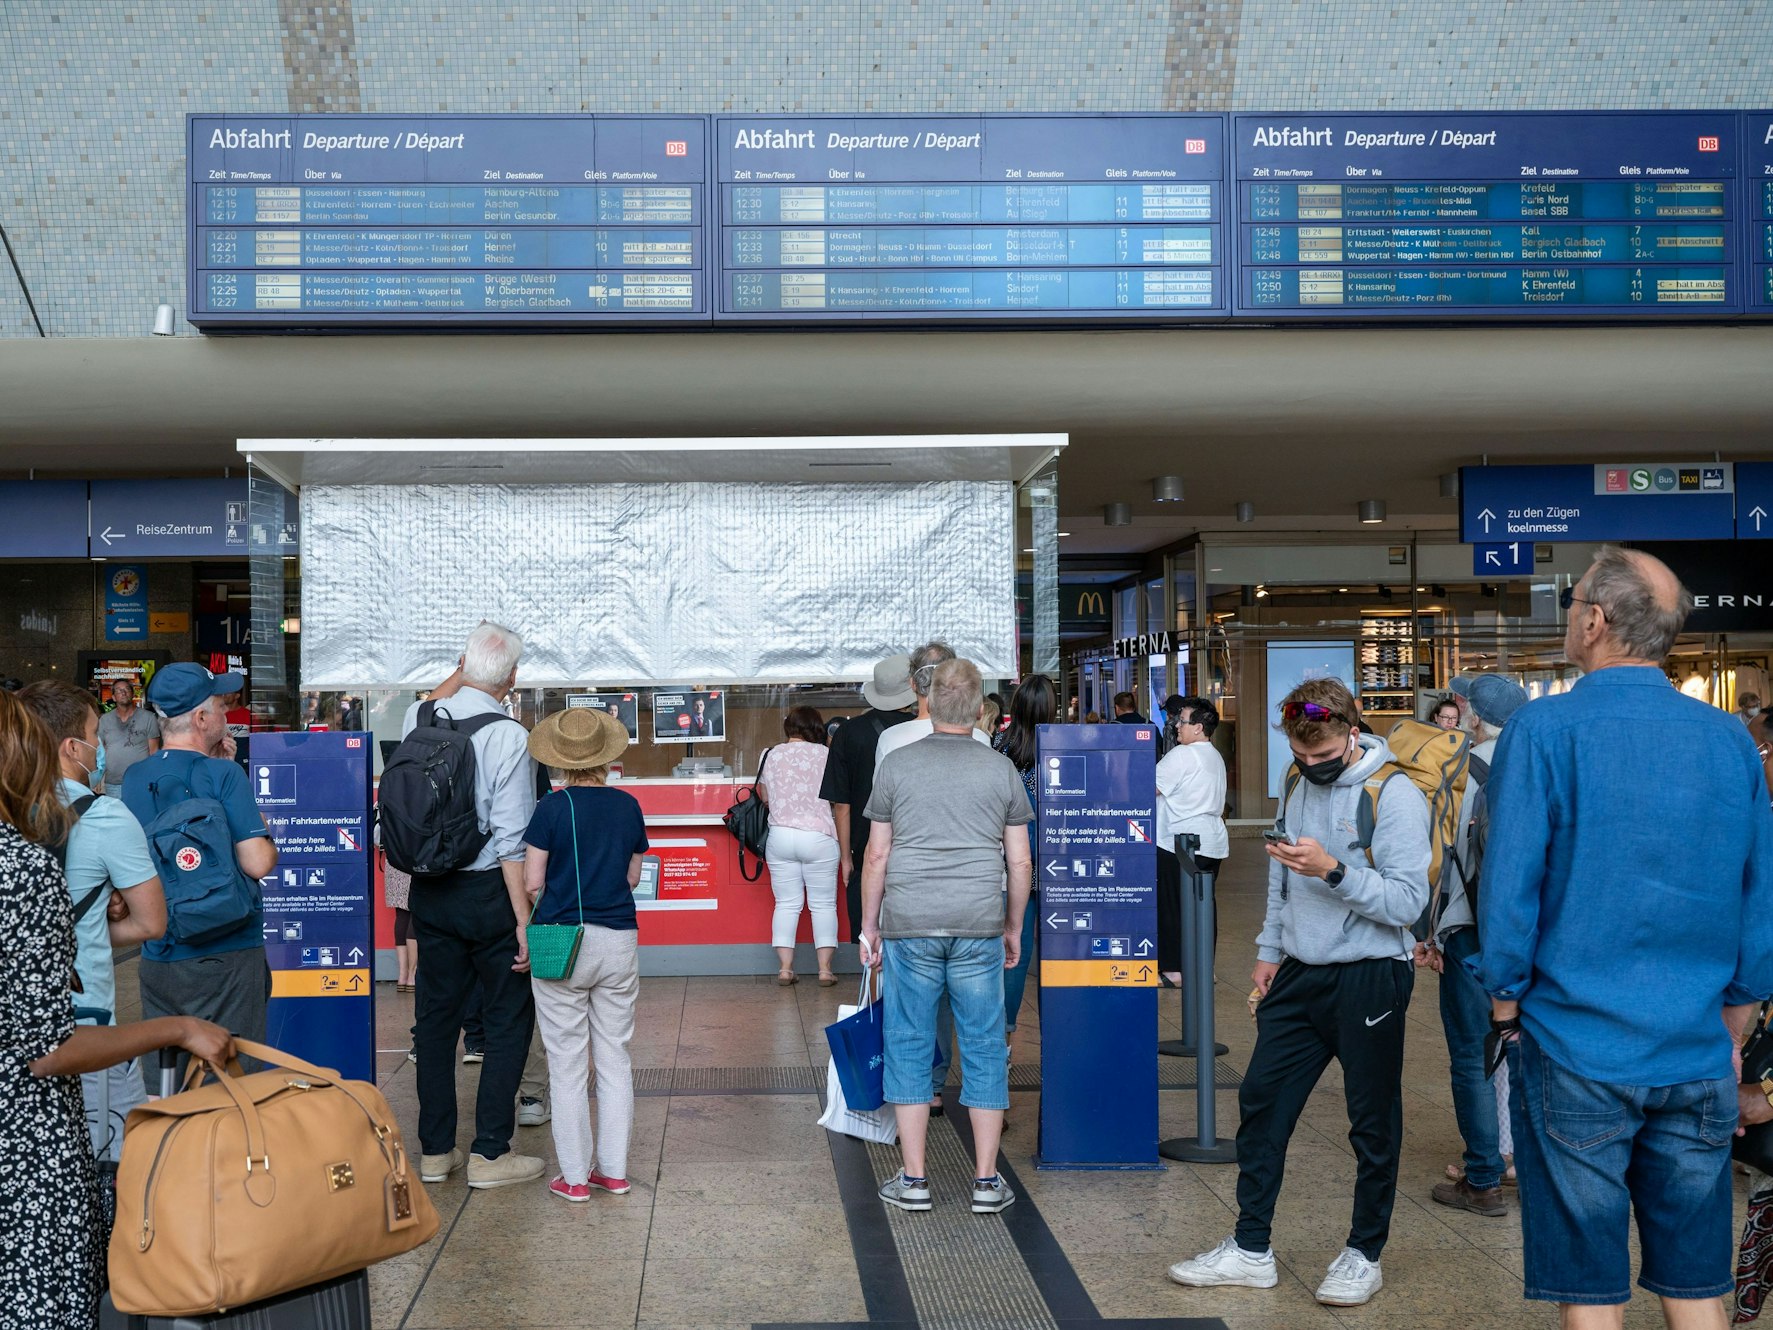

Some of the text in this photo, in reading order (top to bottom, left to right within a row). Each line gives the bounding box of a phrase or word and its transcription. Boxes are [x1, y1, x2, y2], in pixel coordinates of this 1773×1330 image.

[209, 128, 292, 149] Abfahrt
[303, 132, 390, 152] Departure
[405, 132, 464, 152] Départ
[734, 129, 815, 149] Abfahrt
[827, 132, 909, 152] Departure
[924, 132, 981, 151] Départ
[1253, 127, 1333, 147] Abfahrt
[1344, 130, 1426, 149] Departure
[1441, 130, 1496, 149] Départ
[667, 142, 685, 154] DB
[1186, 141, 1204, 152] DB
[1700, 138, 1717, 150] DB
[209, 170, 271, 180] Zeit Time/Temps
[305, 168, 326, 179] Über
[484, 170, 500, 179] Ziel
[584, 170, 657, 180] Gleis Platform/Voie
[734, 170, 795, 180] Zeit Time/Temps
[829, 168, 849, 179] Über
[1006, 168, 1022, 178] Ziel
[1105, 168, 1176, 178] Gleis Platform/Voie
[1253, 168, 1313, 177] Zeit Time/Temps
[1346, 166, 1366, 176] Über
[1520, 166, 1579, 176] Ziel Destination
[1620, 166, 1690, 176] Gleis Platform/Voie
[1521, 184, 1555, 192] Krefeld
[1548, 195, 1569, 204] Nord
[1521, 207, 1568, 215] Basel SBB
[1256, 228, 1280, 236] 12:46
[1521, 226, 1540, 235] Kall
[1635, 226, 1641, 234] 7
[211, 243, 237, 252] 12:21
[596, 243, 607, 251] 10
[1256, 251, 1280, 260] 12:48
[1522, 250, 1602, 258] Berlin Ostbahnhof
[212, 275, 237, 283] 12:24
[1256, 282, 1281, 291] 12:50
[1522, 280, 1575, 289] K Ehrenfeld
[1632, 280, 1642, 289] 11
[212, 286, 237, 295] 12:25
[737, 286, 762, 294] 12:40
[1523, 292, 1564, 301] Troisdorf
[1631, 292, 1642, 300] 10
[212, 298, 237, 307] 12:27
[1508, 507, 1580, 520] zu den Zügen
[136, 524, 212, 535] ReiseZentrum
[1507, 522, 1568, 533] koelnmesse
[1508, 542, 1518, 564] 1
[1694, 595, 1773, 607] ERN
[220, 617, 232, 644] 1
[1113, 631, 1170, 660] ETERNA
[291, 817, 361, 825] Fahrkartenverkauf
